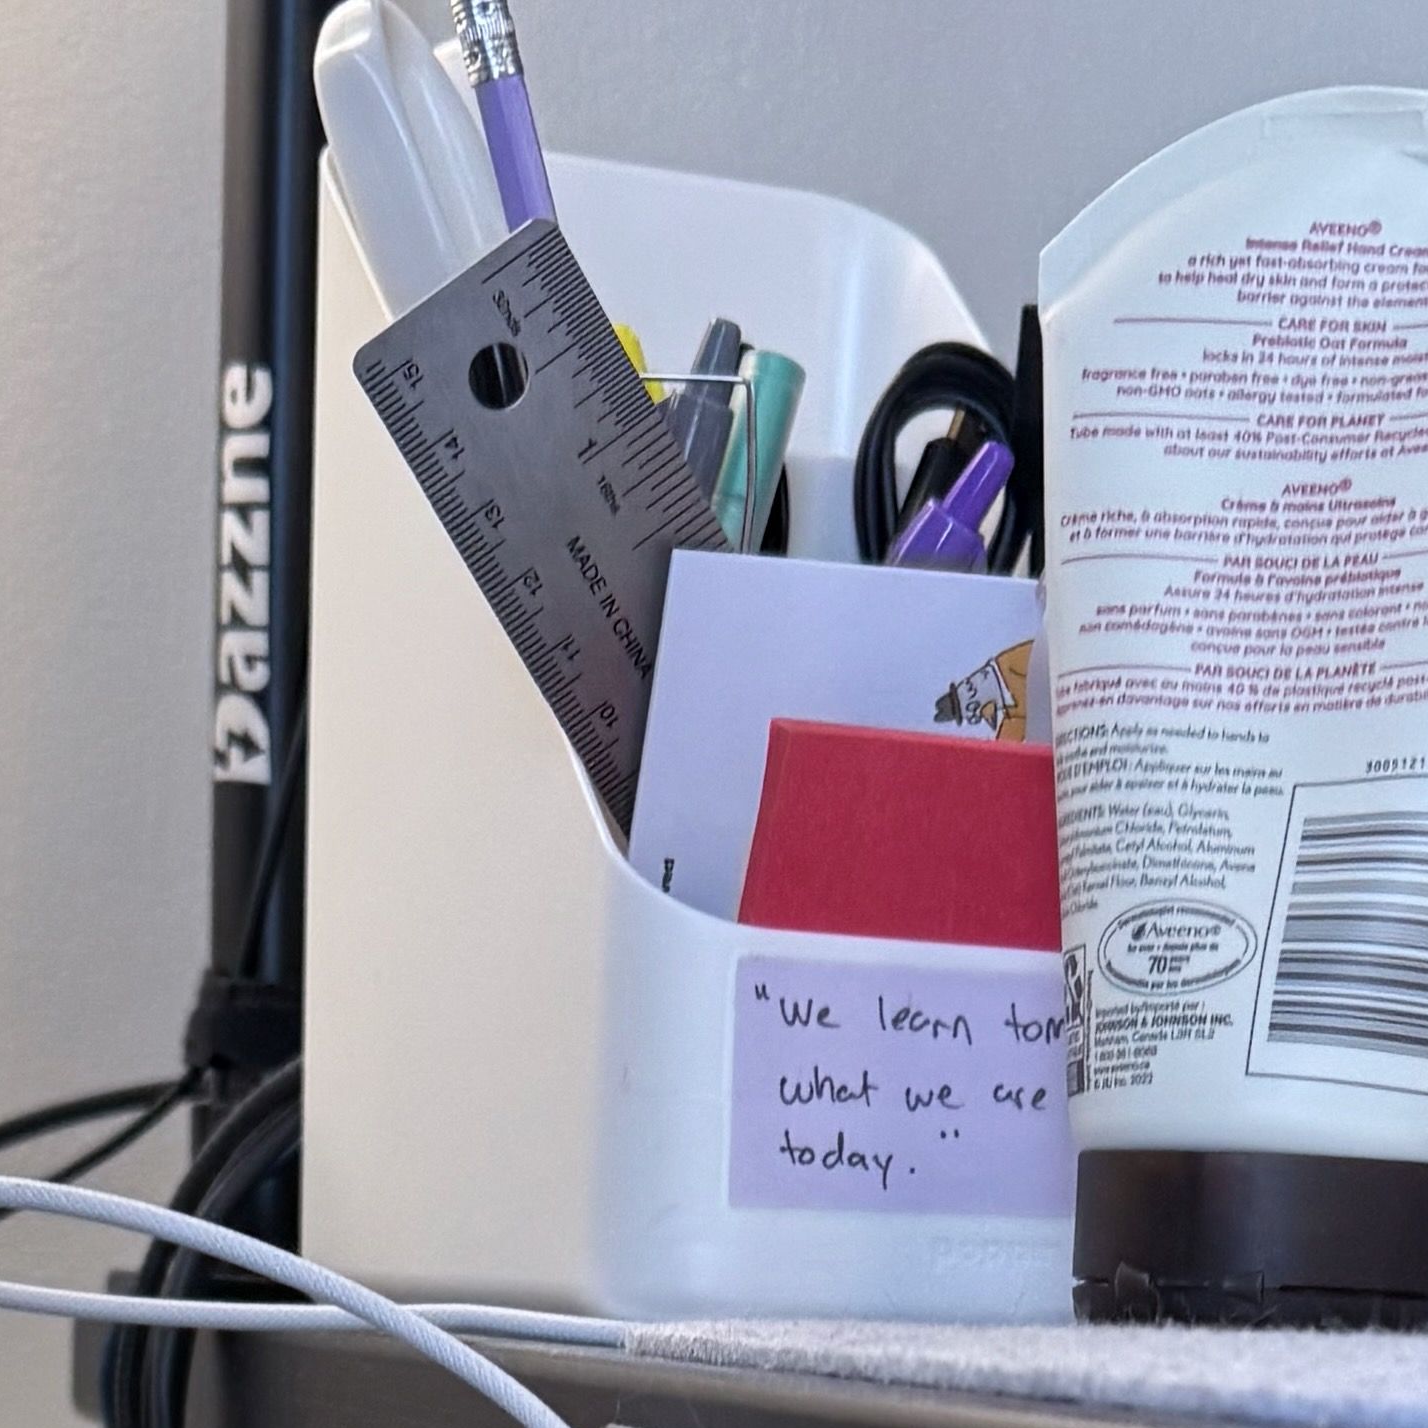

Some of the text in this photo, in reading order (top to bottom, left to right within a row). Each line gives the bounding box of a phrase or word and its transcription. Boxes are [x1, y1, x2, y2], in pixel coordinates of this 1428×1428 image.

[1200, 253, 1225, 268] rich
[1364, 263, 1409, 275] cream
[1175, 269, 1204, 287] help
[1208, 271, 1238, 285] heal
[1242, 272, 1265, 289] dry
[1269, 274, 1297, 288] skin
[1300, 276, 1327, 289] and
[1332, 278, 1365, 291] form
[1237, 290, 1286, 303] barrier
[1290, 293, 1343, 308] against
[1347, 296, 1370, 308] the
[1278, 317, 1387, 333] CARE FOR SKIN
[1320, 337, 1346, 349] Oat
[1349, 336, 1408, 350] Formula
[1278, 352, 1317, 366] hours
[1151, 367, 1177, 380] free
[1189, 370, 1248, 385] paraben
[1251, 371, 1280, 384] free
[1321, 372, 1349, 386] free
[1227, 388, 1277, 404] allergy
[1256, 414, 1294, 428] CARE
[1298, 415, 1328, 429] FOR
[1145, 425, 1173, 439] with
[1195, 428, 1229, 442] least
[1233, 430, 1262, 444] 40%
[566, 535, 654, 680] MADE IN CHINA
[1147, 955, 1168, 975] 70
[878, 995, 972, 1046] learn
[778, 1065, 1047, 1112] what we are
